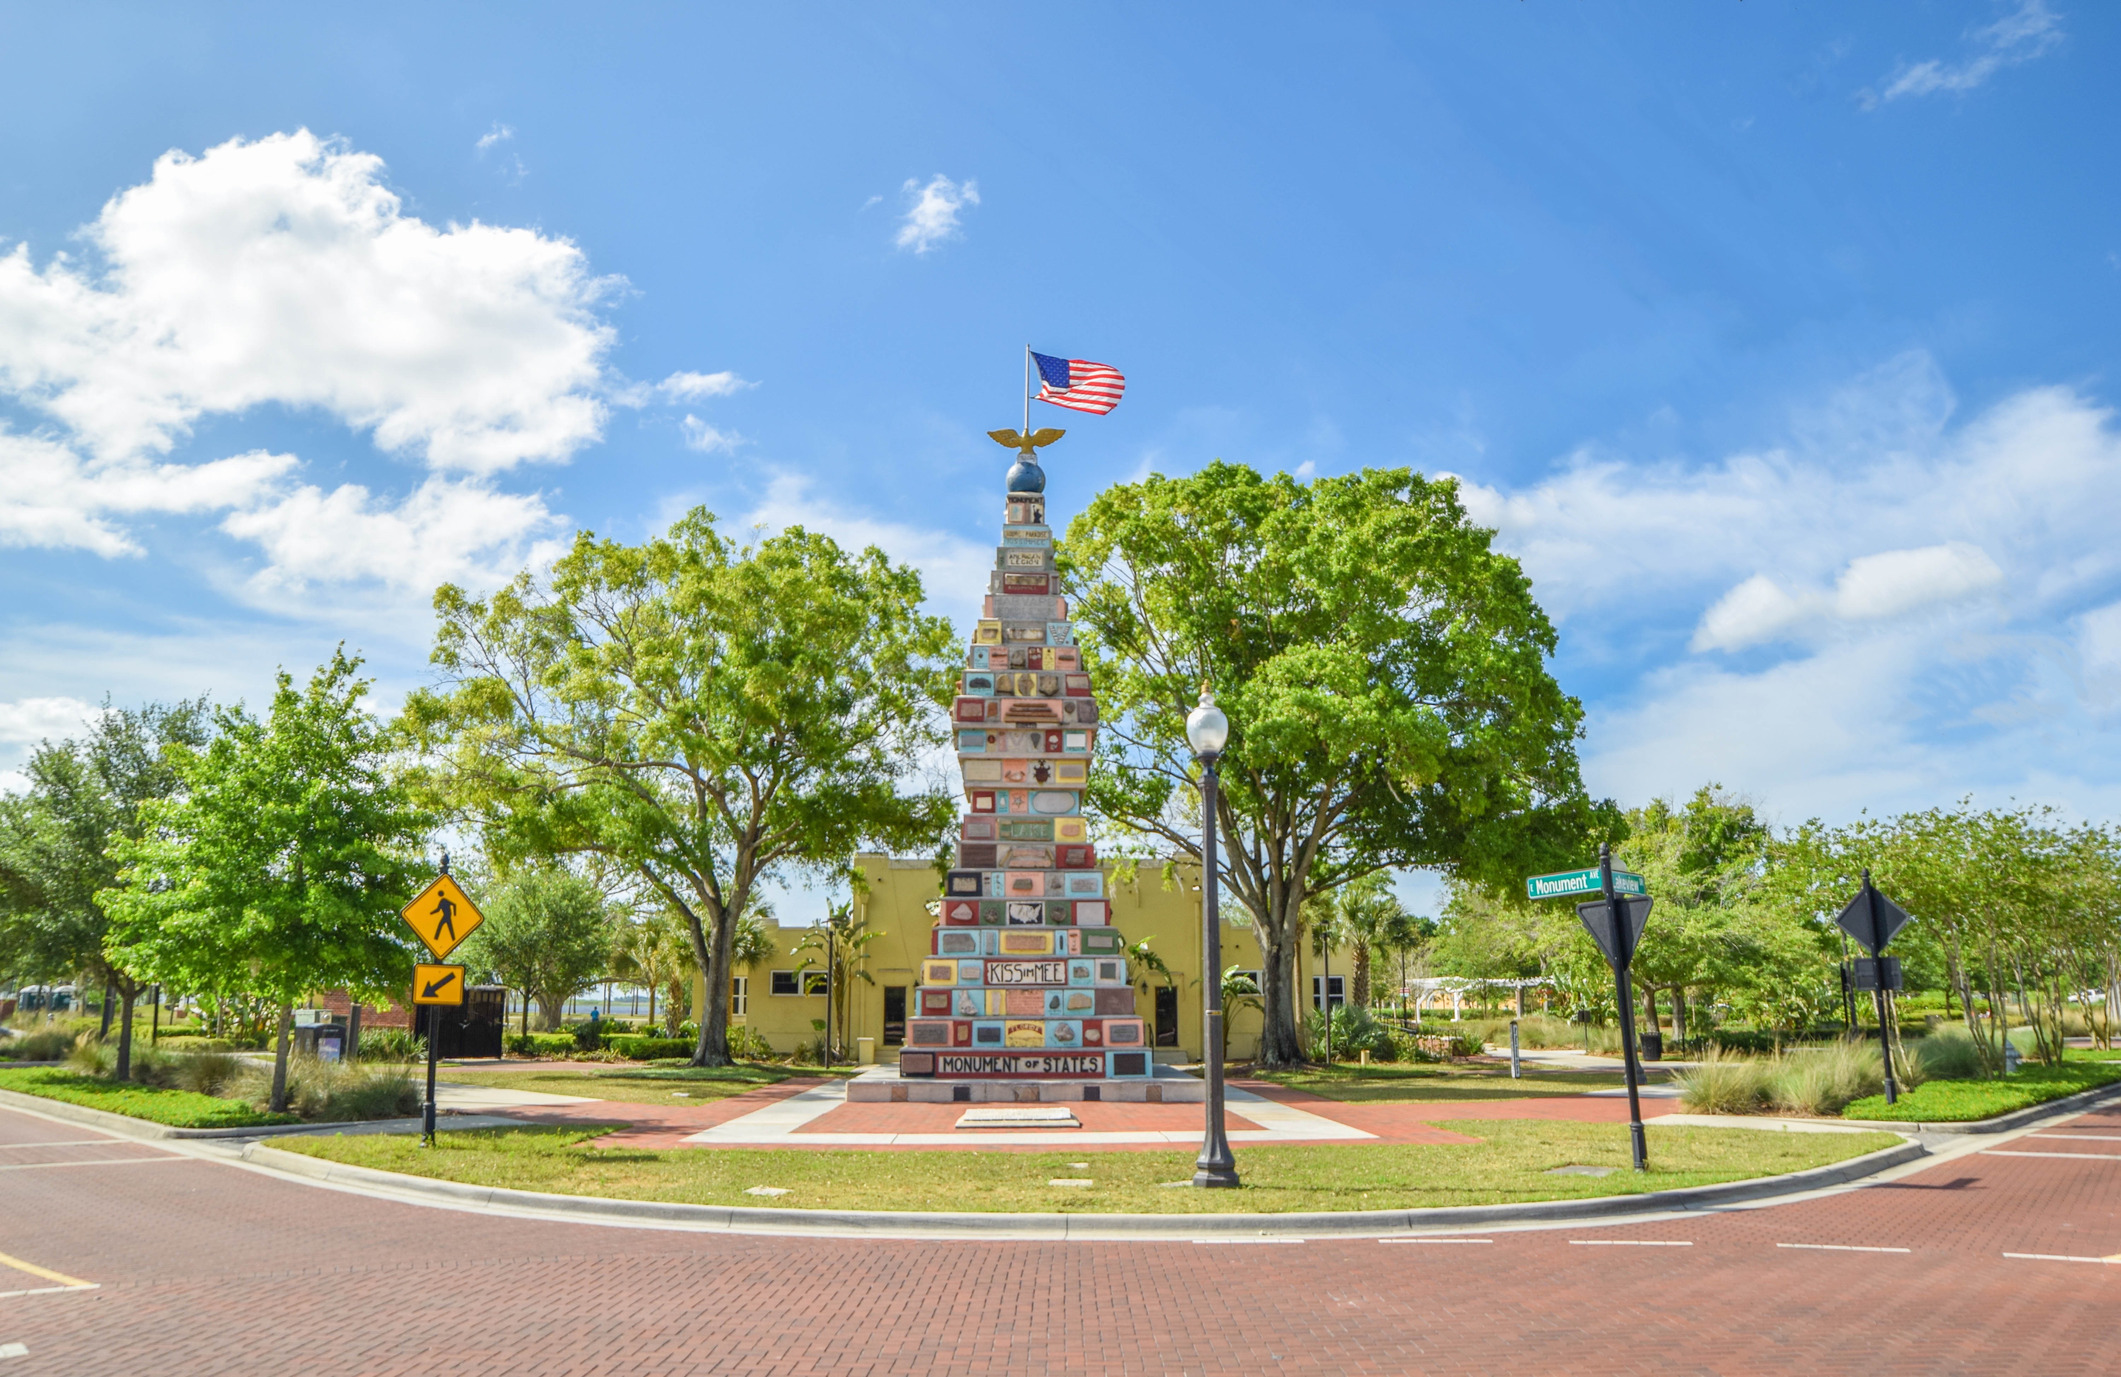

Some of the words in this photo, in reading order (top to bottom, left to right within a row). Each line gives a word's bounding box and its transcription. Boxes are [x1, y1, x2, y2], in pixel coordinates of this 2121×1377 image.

[1529, 884, 1534, 893] E
[1535, 873, 1588, 895] Monument
[1589, 870, 1600, 880] AVE
[1613, 875, 1639, 892] akeview
[943, 1057, 1021, 1073] MONUMENT
[1043, 1057, 1099, 1073] STATES
